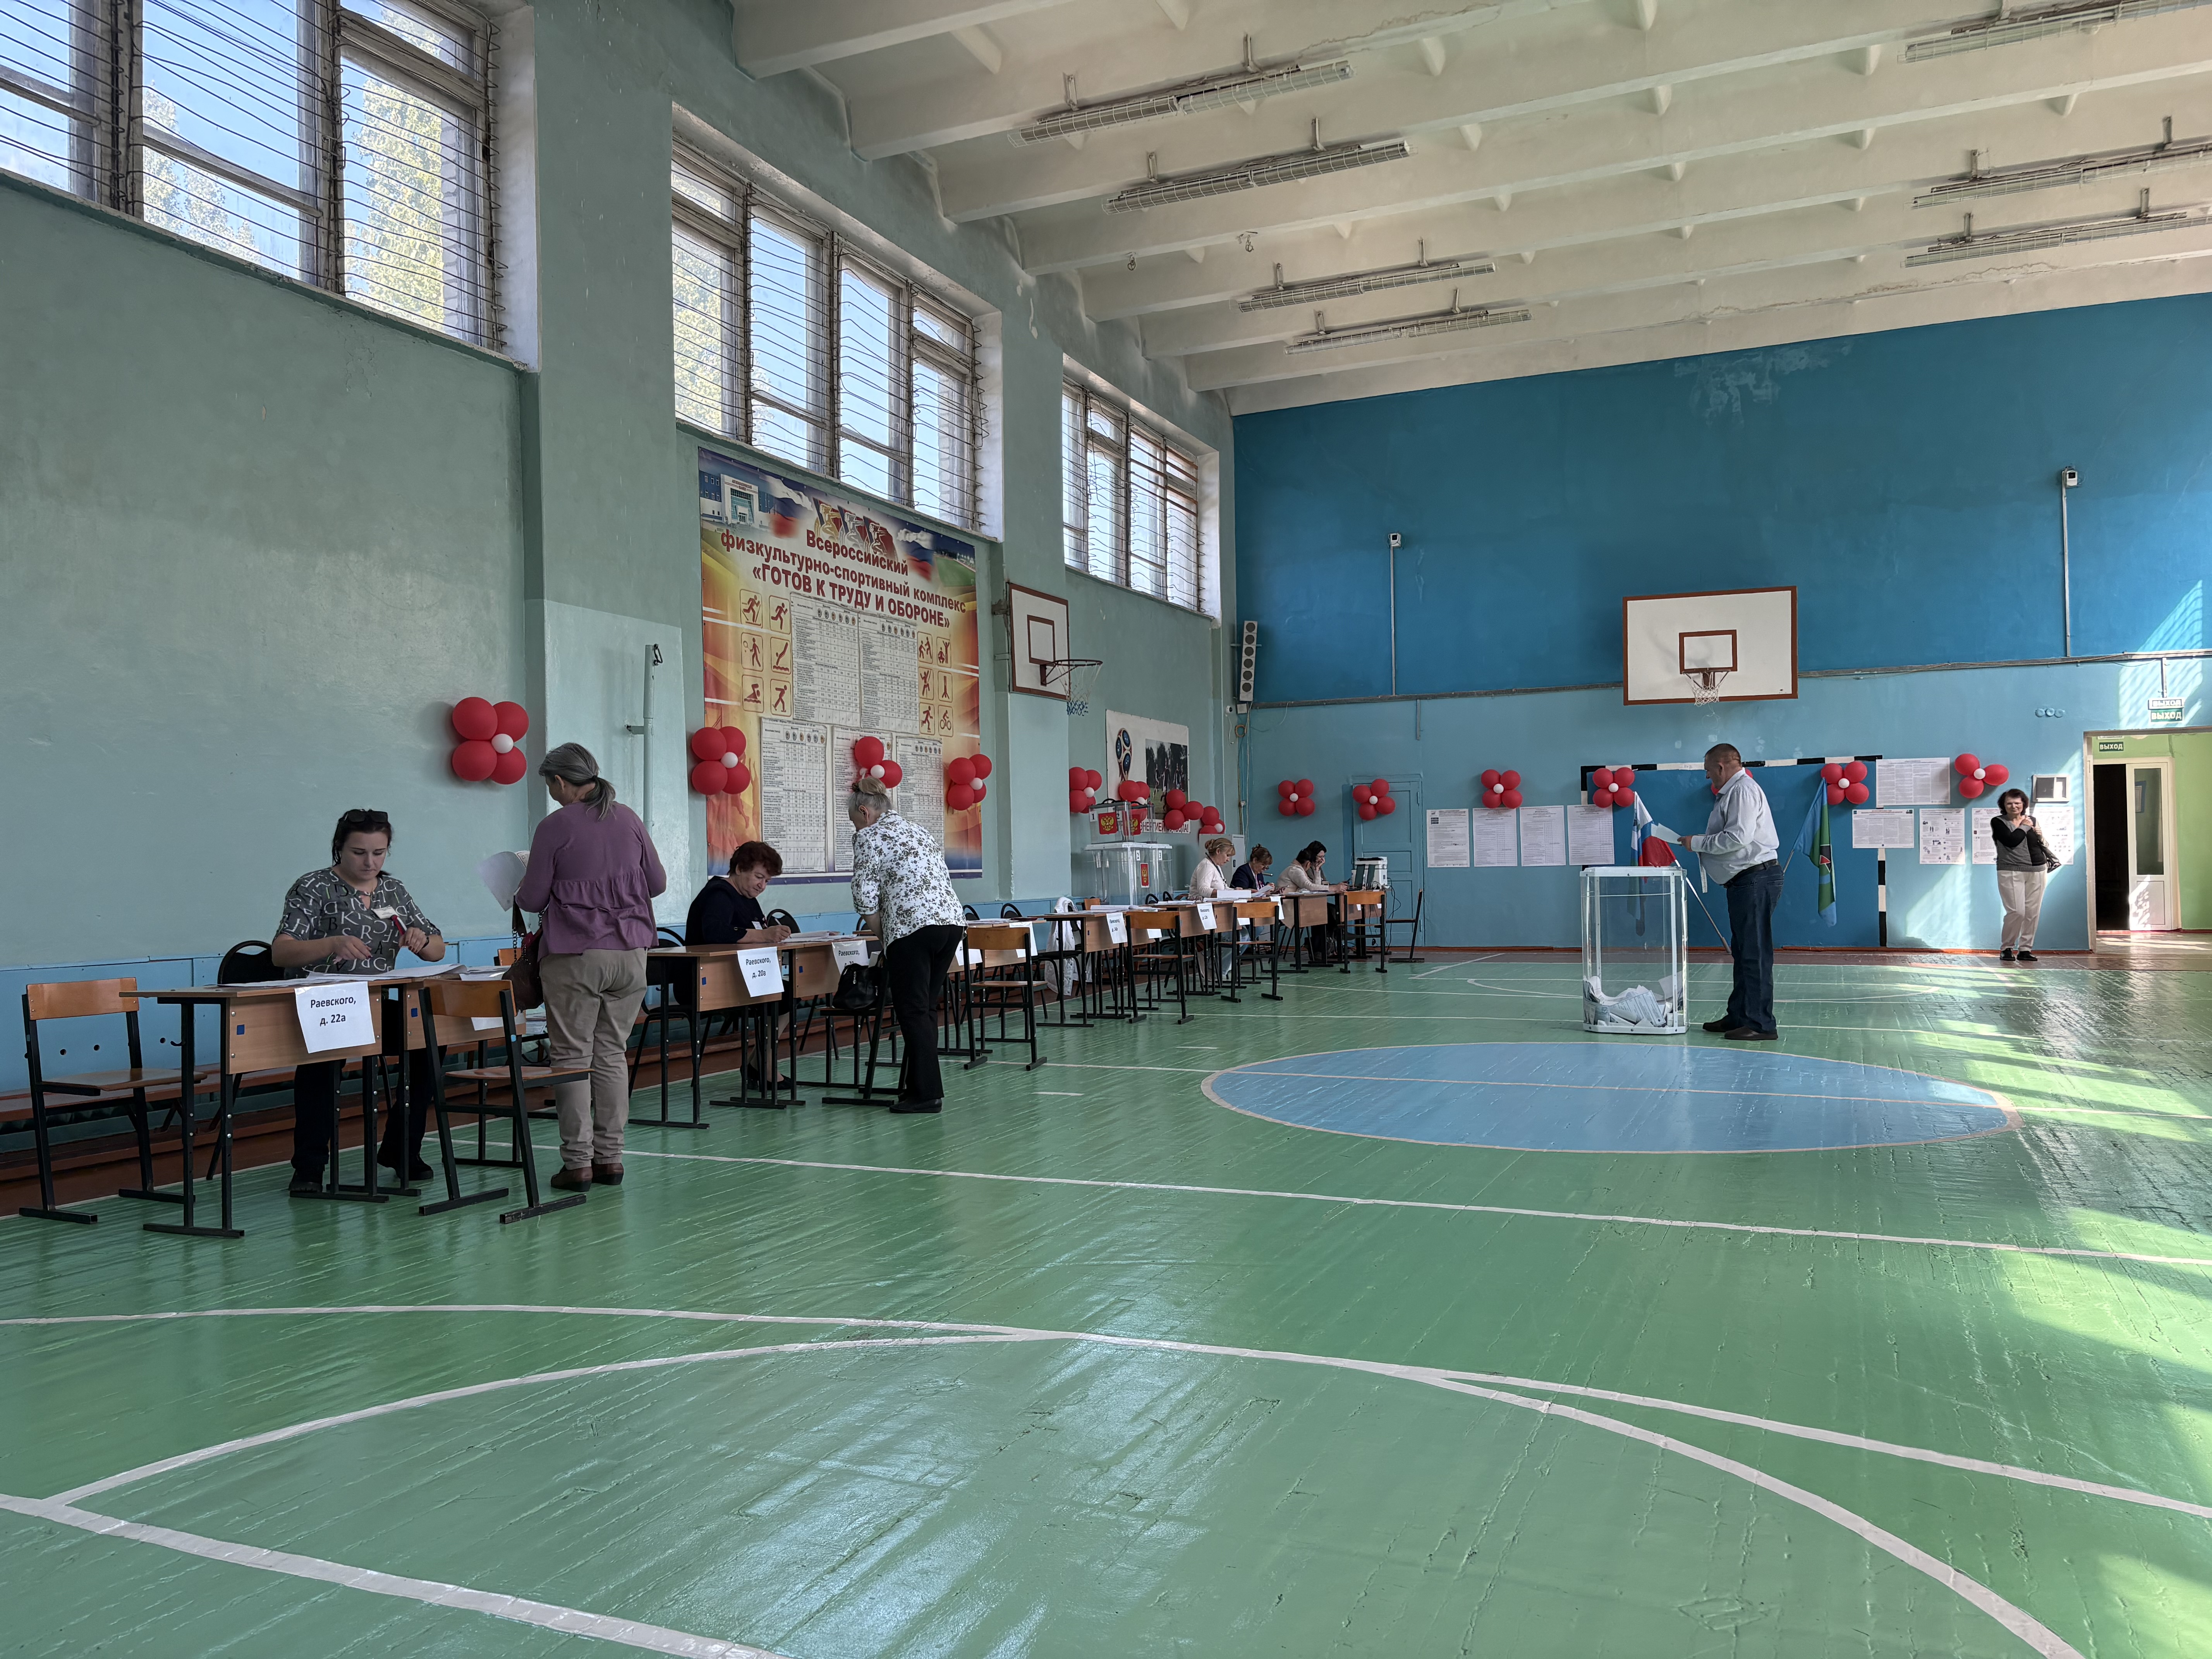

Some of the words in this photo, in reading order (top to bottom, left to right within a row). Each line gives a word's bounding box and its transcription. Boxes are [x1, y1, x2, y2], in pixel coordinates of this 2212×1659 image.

[807, 529, 908, 576] Всероссийский
[721, 529, 910, 598] физкультурно-спортивный
[914, 588, 966, 613] комплекс
[753, 563, 812, 593] «ГОТОВ
[816, 578, 826, 597] К
[829, 582, 871, 611] ТРУДУ
[875, 594, 884, 612] И
[888, 598, 950, 628] ОБОРОНЕ»
[2151, 711, 2182, 720] ВЫХОД
[311, 997, 356, 1008] Раевского,
[320, 1018, 328, 1027] д.
[331, 1014, 346, 1023] 22а
